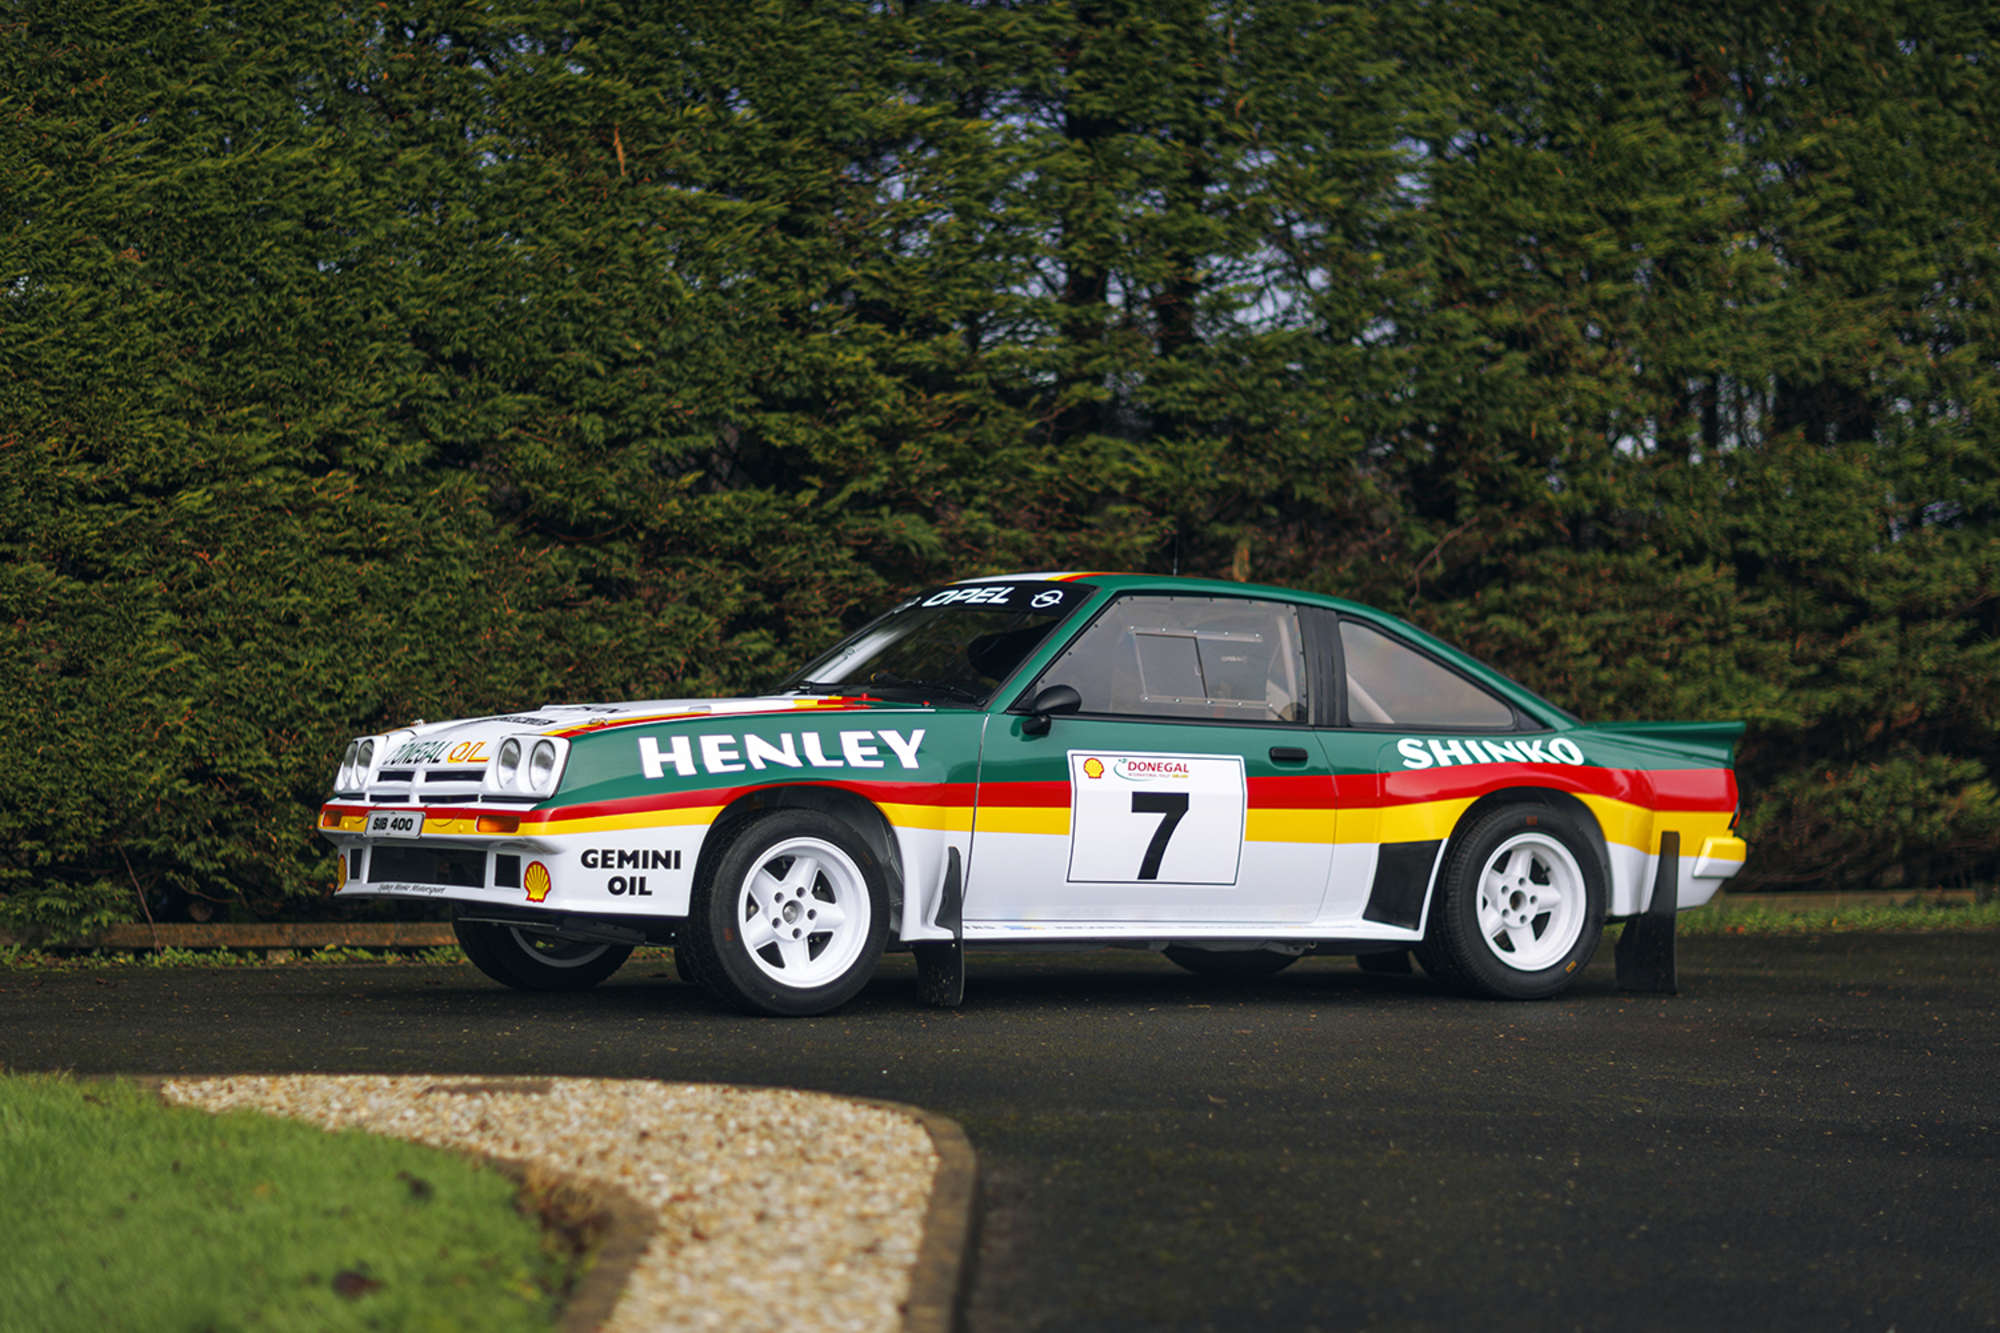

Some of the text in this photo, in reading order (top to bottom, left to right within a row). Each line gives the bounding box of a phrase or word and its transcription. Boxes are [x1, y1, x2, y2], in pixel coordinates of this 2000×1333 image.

[922, 586, 1015, 607] OPEL
[448, 741, 490, 763] OIL
[638, 729, 926, 778] HENLEY
[1396, 738, 1584, 769] SHINKO
[1128, 761, 1189, 773] DONEGAL
[373, 817, 413, 831] SIB 400
[1131, 791, 1190, 880] 7
[581, 849, 681, 870] GEMINI
[608, 876, 653, 896] OIL
